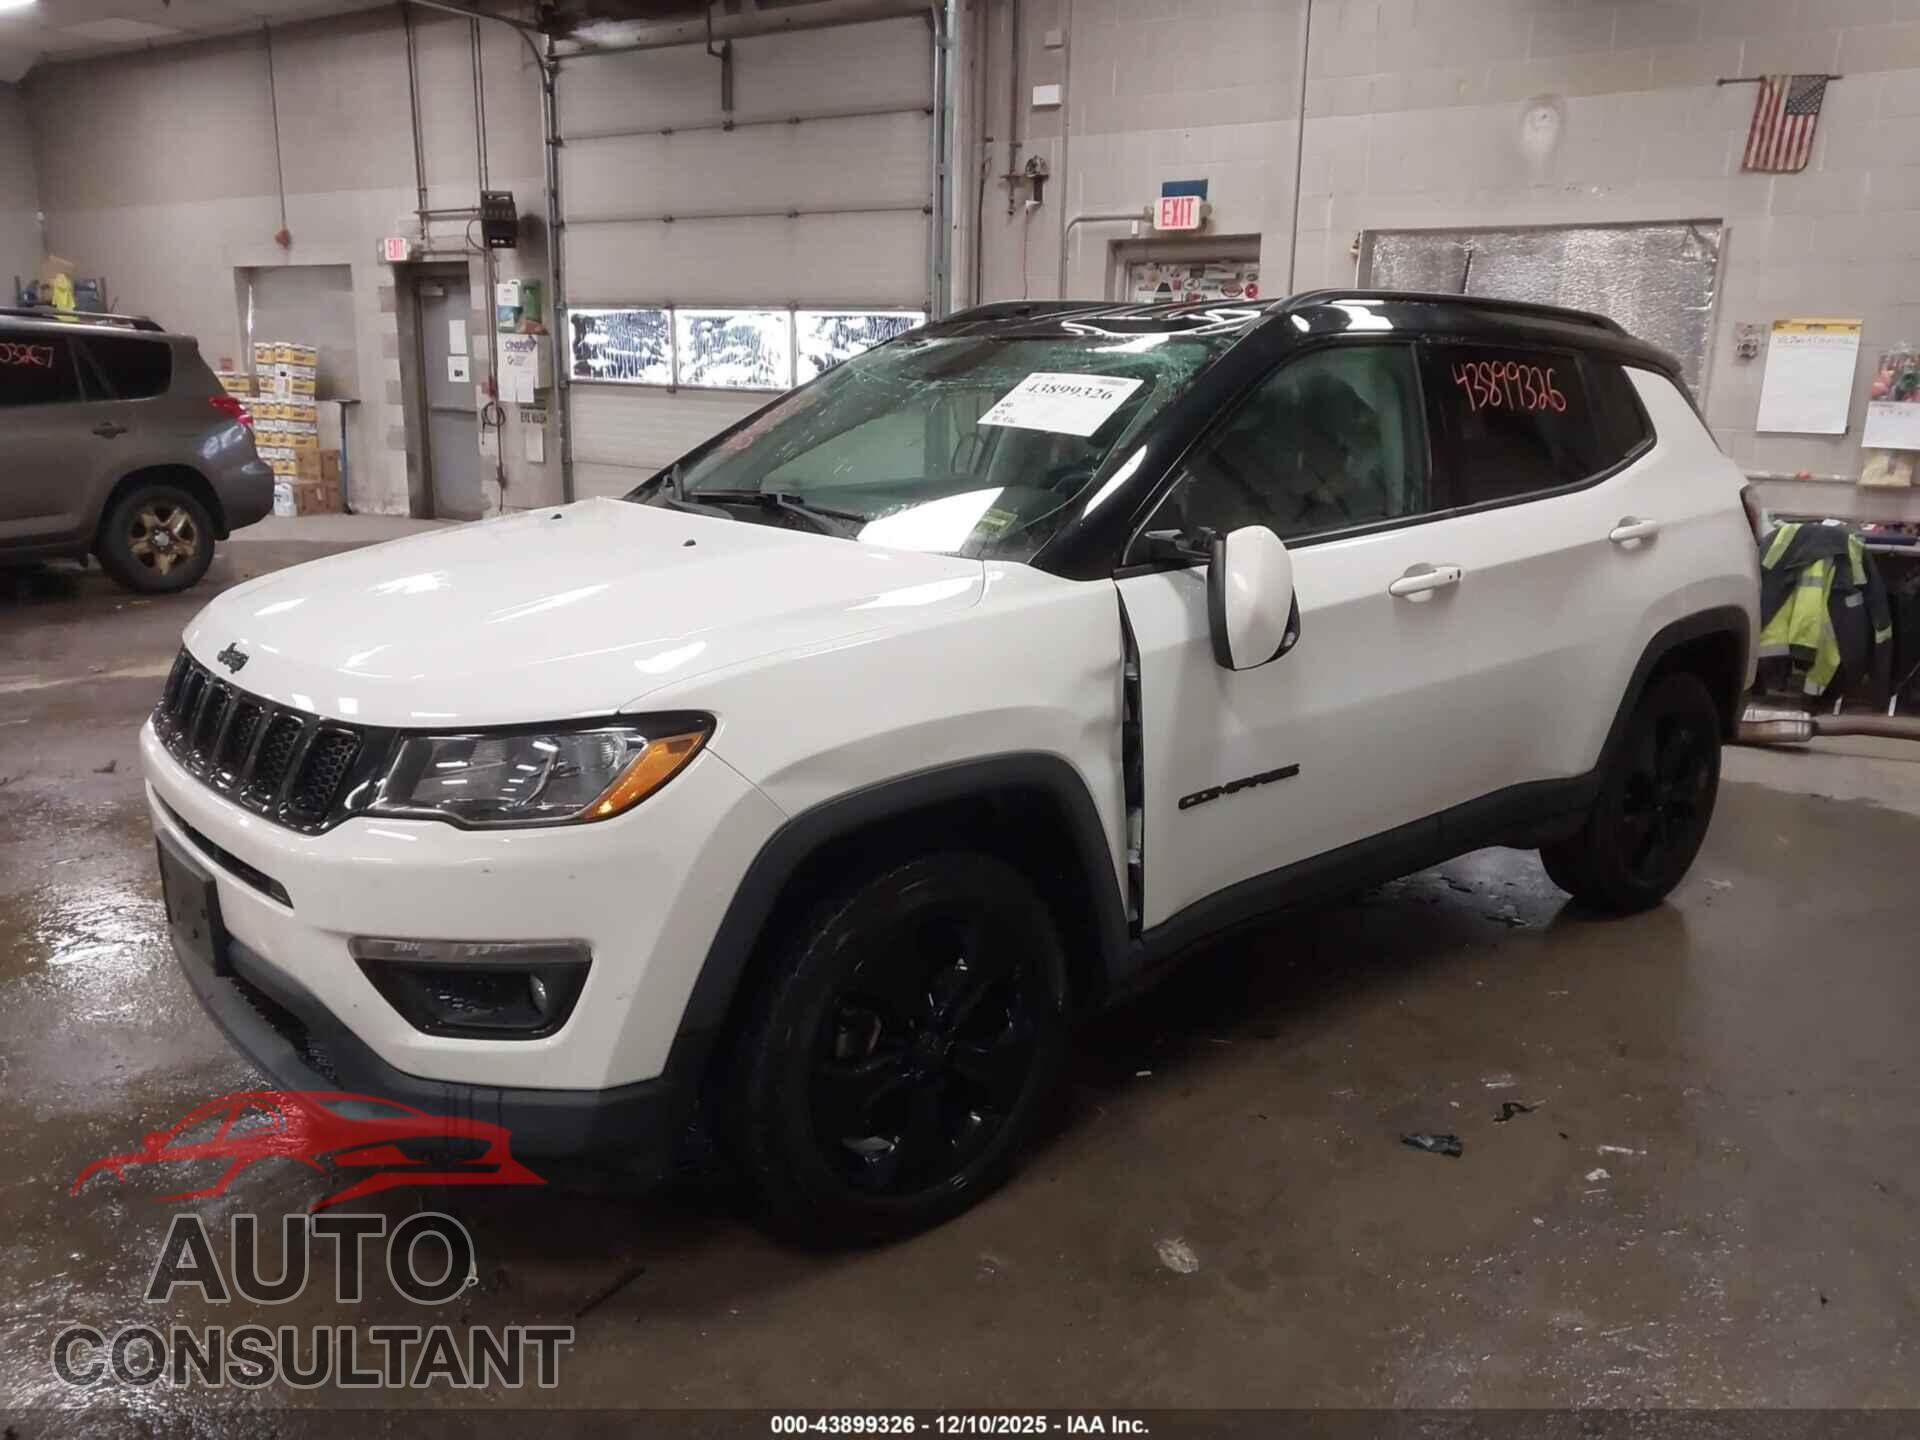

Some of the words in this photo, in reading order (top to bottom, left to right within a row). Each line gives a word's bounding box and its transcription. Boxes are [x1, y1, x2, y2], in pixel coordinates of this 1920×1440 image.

[1161, 198, 1195, 227] EXIT
[387, 239, 405, 258] EXIT
[1025, 383, 1113, 401] 43899326
[1451, 360, 1567, 412] 43899326
